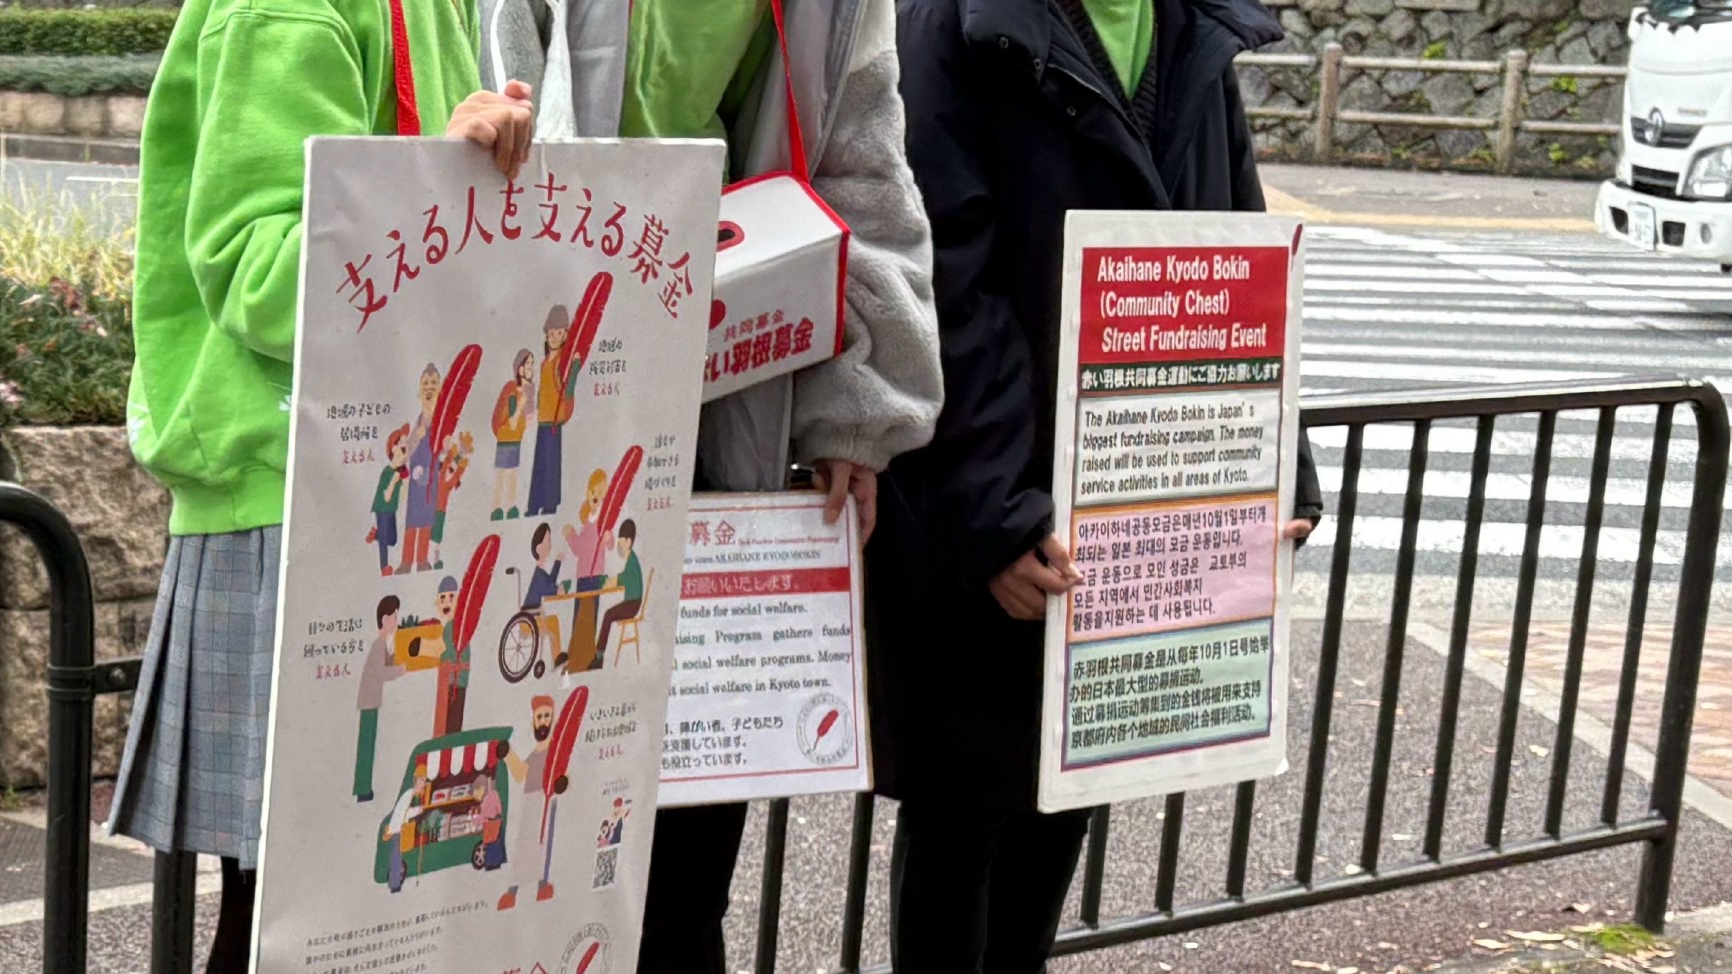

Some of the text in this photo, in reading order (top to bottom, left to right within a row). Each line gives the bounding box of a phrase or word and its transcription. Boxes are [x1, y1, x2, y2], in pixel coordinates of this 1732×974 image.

[336, 172, 692, 335] 支える人を支える募金
[1097, 255, 1250, 285] Akaihane Kyodo Bokin
[1100, 289, 1230, 319] (Community Chest)
[723, 308, 786, 342] 共同募金
[1101, 322, 1268, 353] Street Fundraising Event
[1081, 363, 1282, 390] 赤い羽根共同募金運動にご協力お願いします
[1085, 410, 1103, 428] The
[1105, 408, 1148, 426] Akaihane
[1150, 406, 1179, 424] Kyodo
[1181, 405, 1205, 422] Bokin
[1207, 404, 1216, 420] is
[1083, 431, 1117, 450] biggest
[1120, 429, 1170, 448] fundraising
[1220, 424, 1235, 440] The
[1237, 424, 1264, 440] money
[1082, 445, 1262, 473] raised will be used to support community
[1081, 466, 1249, 495] service activities in all areas of Kyoto.
[1111, 540, 1131, 560] 일본
[1135, 536, 1166, 557] 최대의
[1169, 534, 1188, 552] 모금
[1192, 529, 1243, 551] 운동입니다.
[1101, 564, 1142, 585] 운동으로
[1146, 560, 1166, 579] 모인
[1169, 557, 1199, 577] 성금은
[1209, 551, 1247, 570] 교토부의
[1073, 577, 1202, 609] 모든 지역에서 민간사회복지
[680, 601, 808, 619] funds for social welfare.
[1148, 603, 1159, 622] 데
[1162, 597, 1215, 620] 사용됩니다.
[715, 630, 762, 644] Program
[773, 626, 813, 642] gathers
[822, 623, 851, 637] funds
[682, 656, 711, 670] social
[716, 654, 756, 668] welfare
[760, 652, 814, 668] programs.
[818, 650, 851, 665] Money
[679, 682, 709, 696] social
[712, 679, 752, 693] welfare
[755, 679, 766, 692] in
[769, 678, 801, 693] Kyoto
